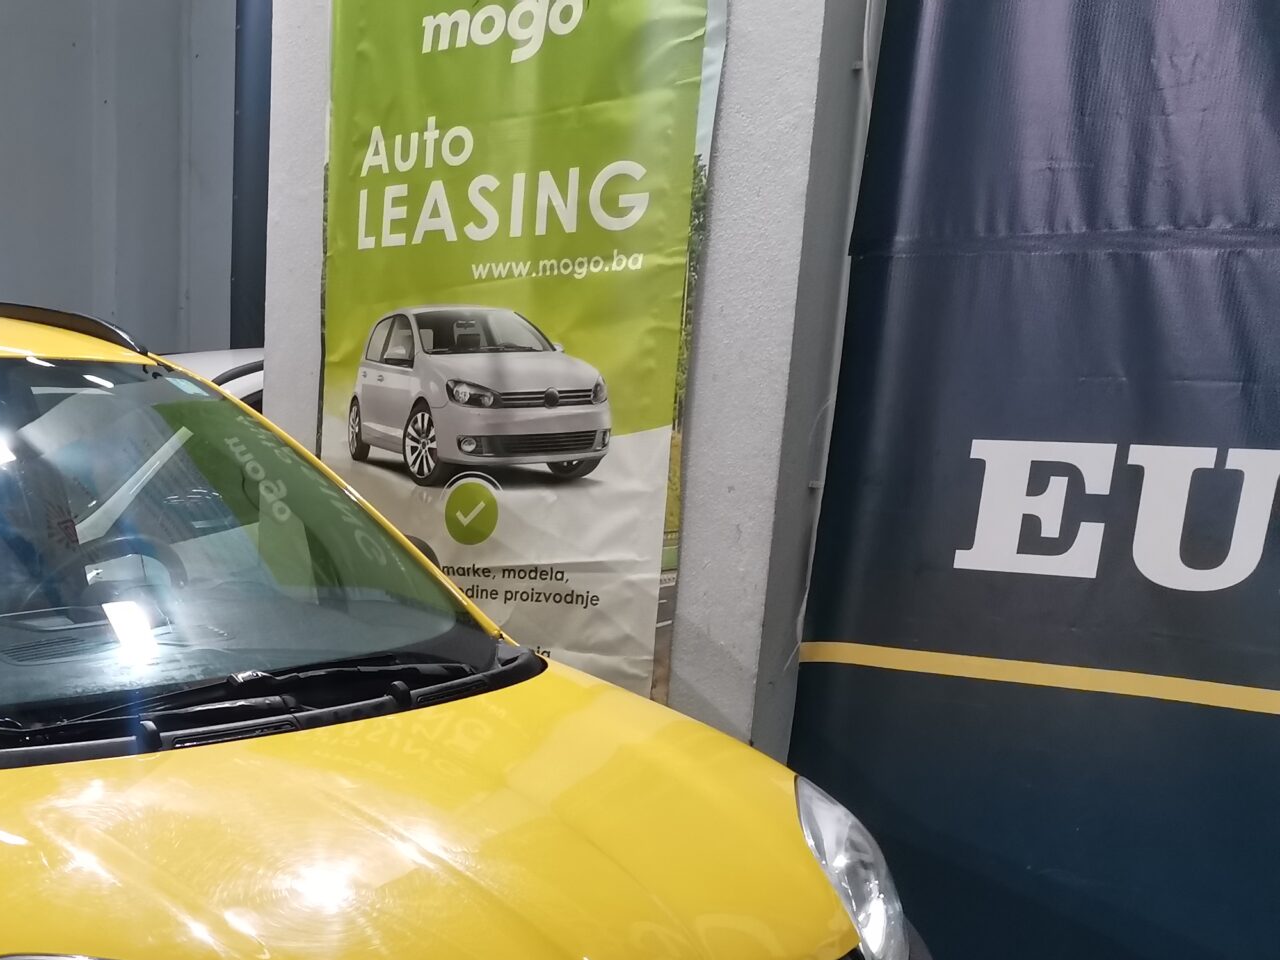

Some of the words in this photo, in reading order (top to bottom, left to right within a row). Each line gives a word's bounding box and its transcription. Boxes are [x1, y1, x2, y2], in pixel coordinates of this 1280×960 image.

[421, 0, 583, 64] mogo
[359, 115, 474, 178] Auto
[357, 160, 650, 251] LEASING
[470, 249, 643, 286] www.mogo.ba
[442, 563, 496, 580] marke,
[502, 566, 569, 584] modela,
[503, 586, 600, 610] proizvodnje
